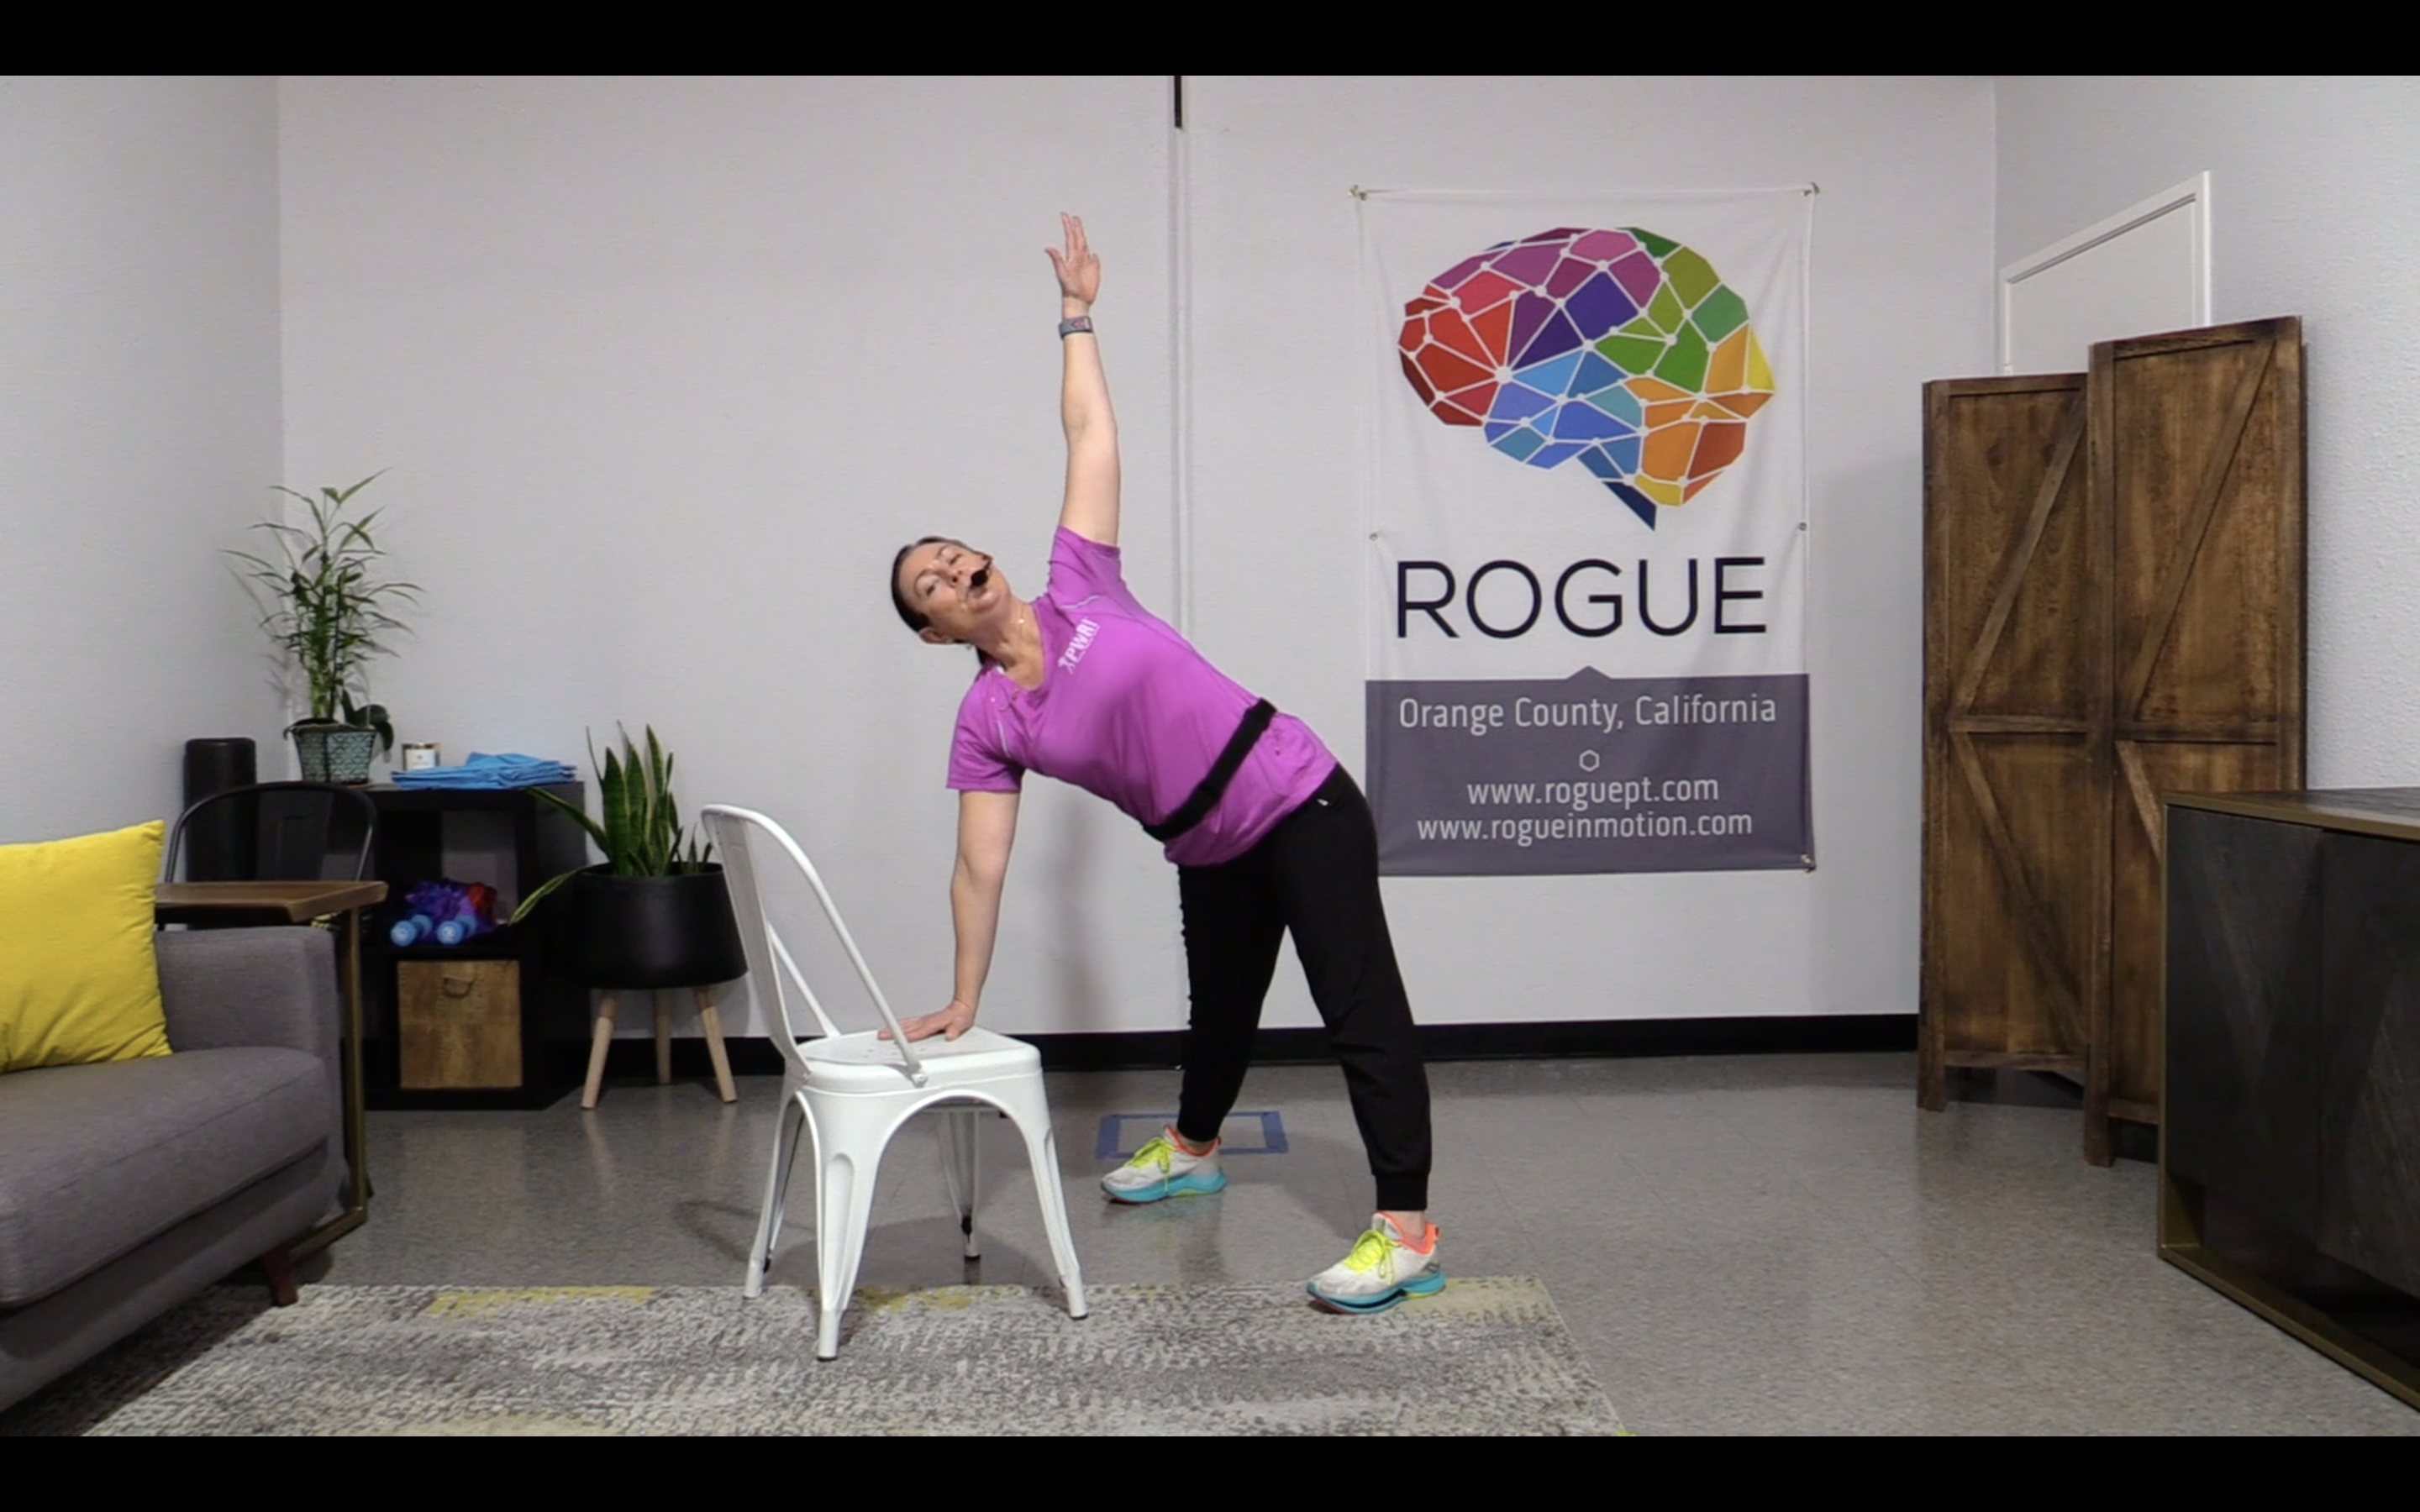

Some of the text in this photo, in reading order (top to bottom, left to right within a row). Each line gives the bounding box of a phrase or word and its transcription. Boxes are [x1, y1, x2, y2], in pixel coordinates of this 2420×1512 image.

[1397, 557, 1767, 638] ROGUE
[1399, 693, 1776, 736] Orange County, California
[1466, 777, 1719, 811] www.roguept.com
[1417, 811, 1753, 847] www.rogueinmotion.com
